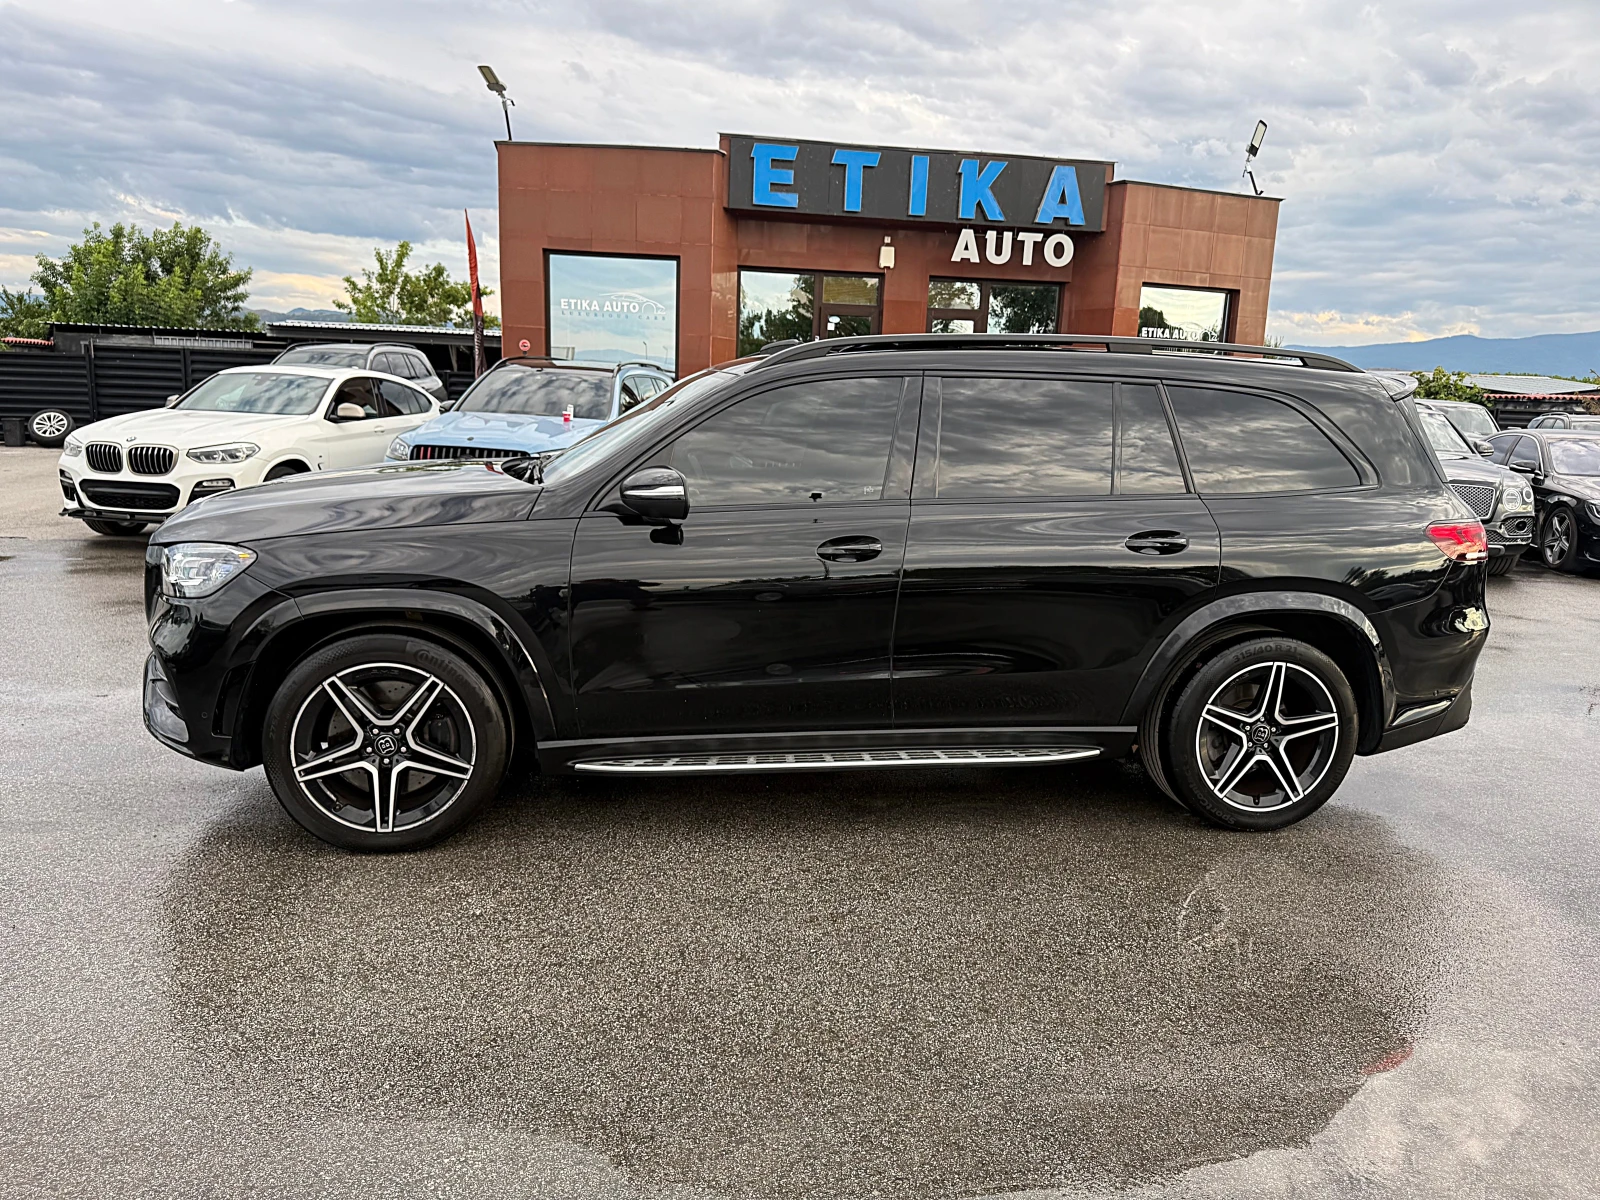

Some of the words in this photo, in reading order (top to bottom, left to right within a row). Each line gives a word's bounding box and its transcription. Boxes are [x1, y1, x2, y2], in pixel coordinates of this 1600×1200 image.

[751, 143, 1085, 226] ETIKA
[951, 229, 1074, 267] AUTO
[560, 299, 600, 311] ETIKA
[603, 301, 640, 313] AUTO
[1141, 327, 1171, 339] ETIKA
